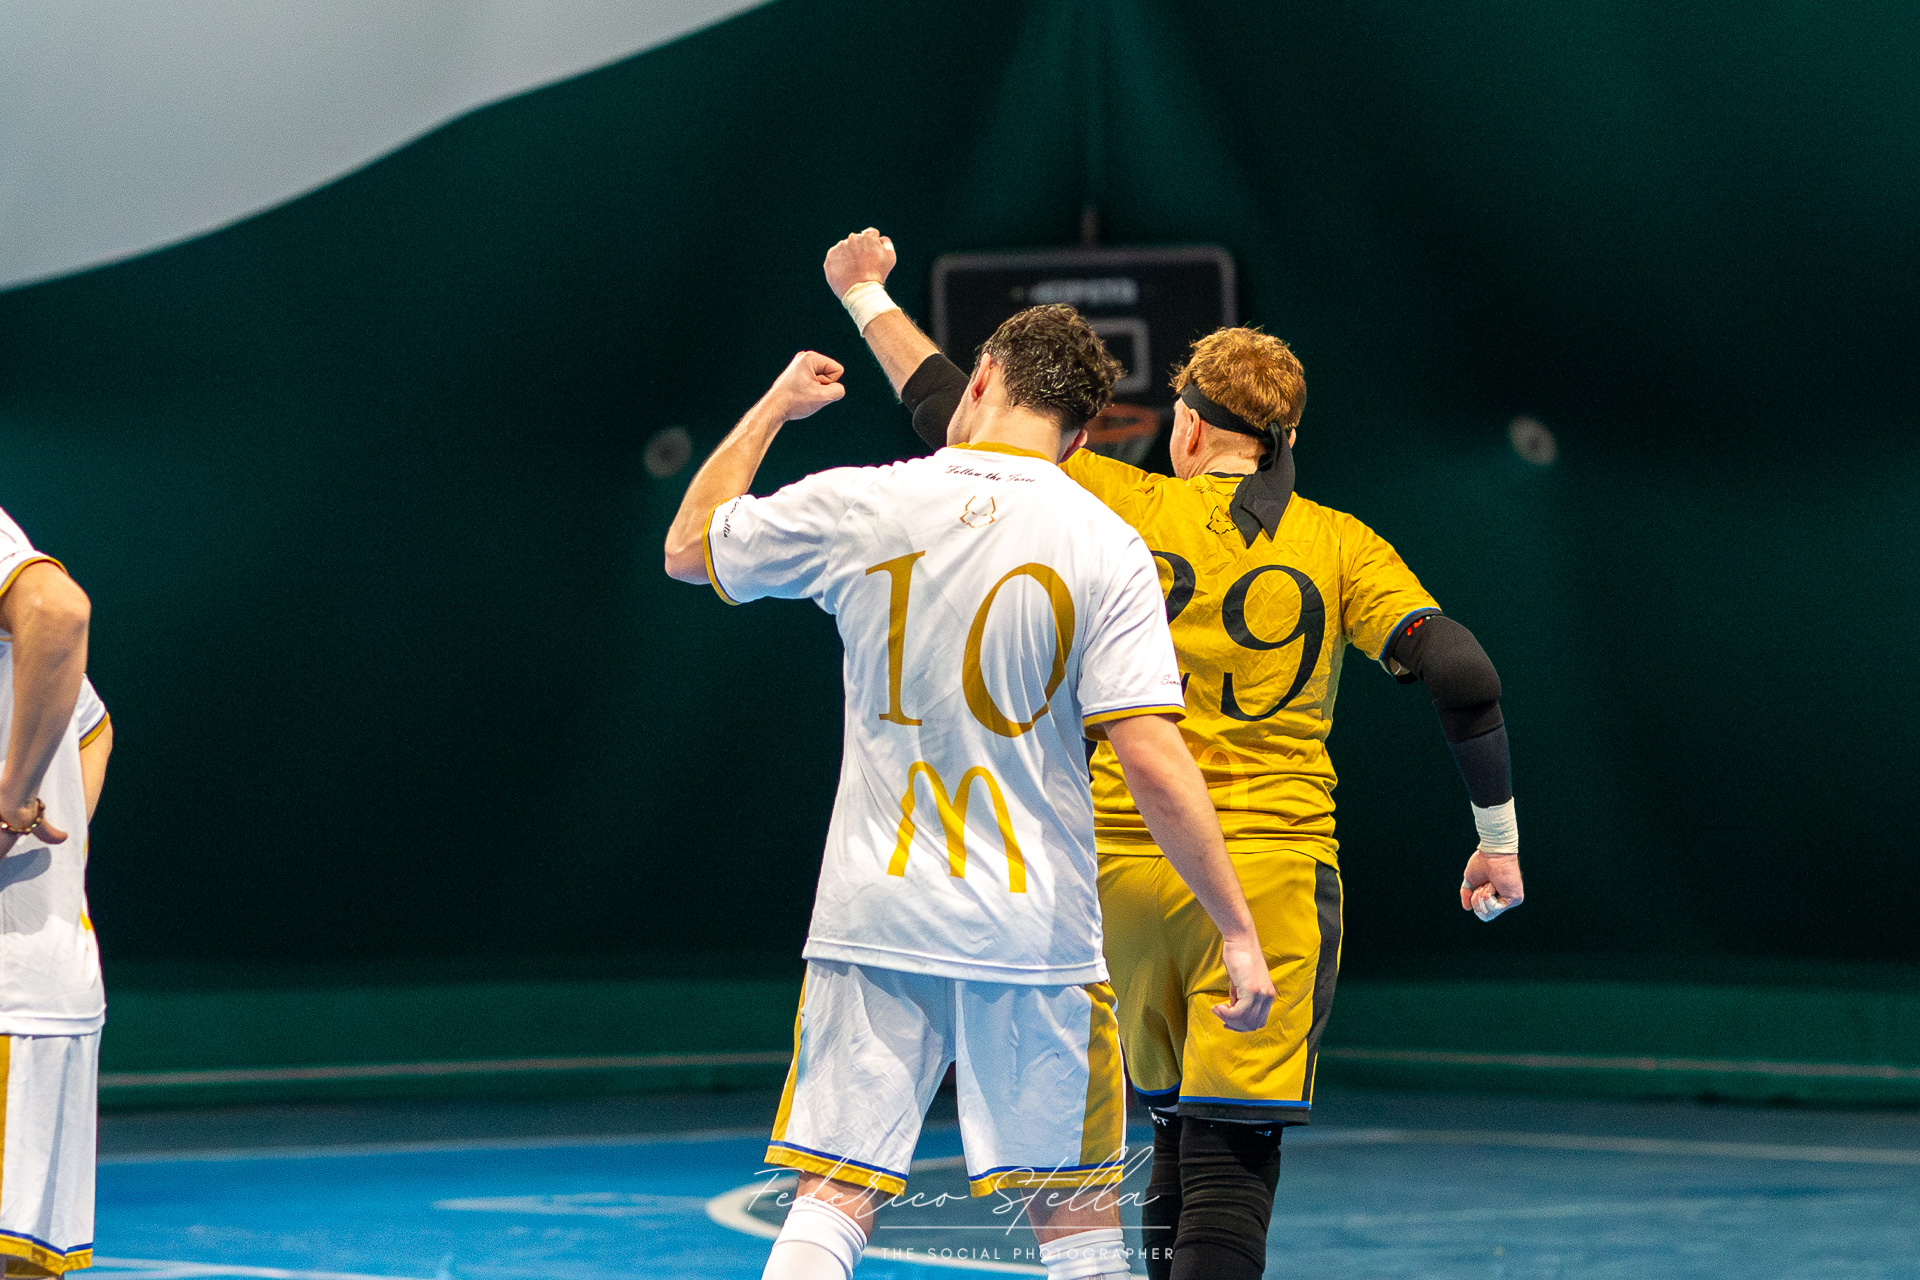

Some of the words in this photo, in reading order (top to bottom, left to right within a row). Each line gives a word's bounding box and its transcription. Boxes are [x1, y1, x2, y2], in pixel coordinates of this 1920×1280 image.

[945, 465, 982, 477] Follow
[984, 473, 1001, 481] the
[865, 550, 1075, 738] 10
